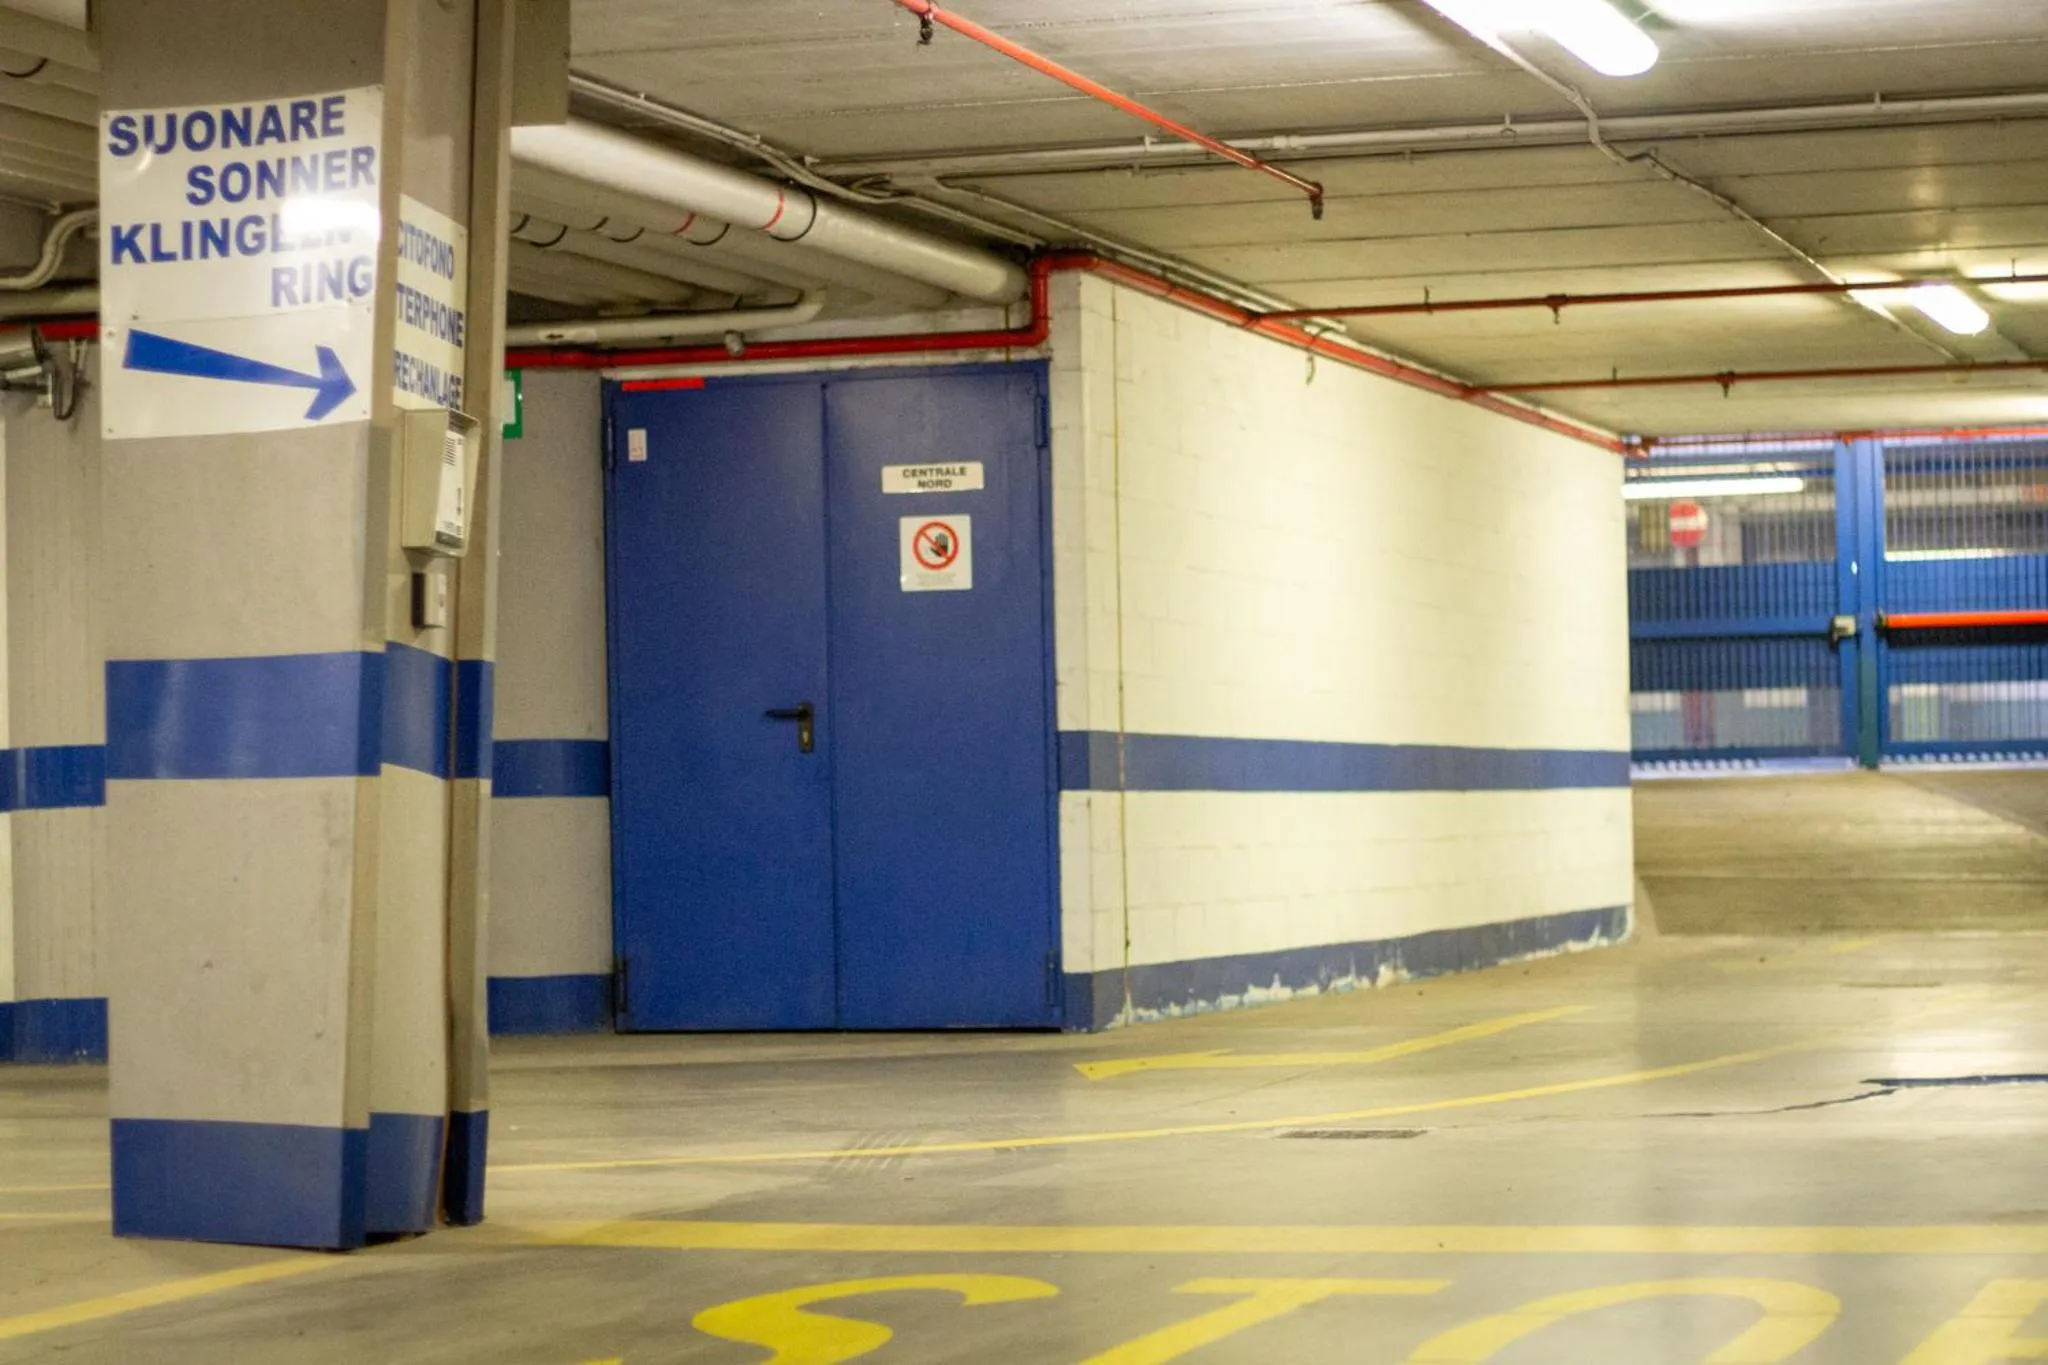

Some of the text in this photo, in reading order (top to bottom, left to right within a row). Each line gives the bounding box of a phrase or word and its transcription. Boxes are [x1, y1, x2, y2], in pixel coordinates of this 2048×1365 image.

[107, 95, 346, 157] SUONARE
[186, 145, 377, 206] SONNER
[270, 255, 373, 308] RING
[902, 466, 967, 478] CENTRALE
[917, 479, 953, 489] NORD
